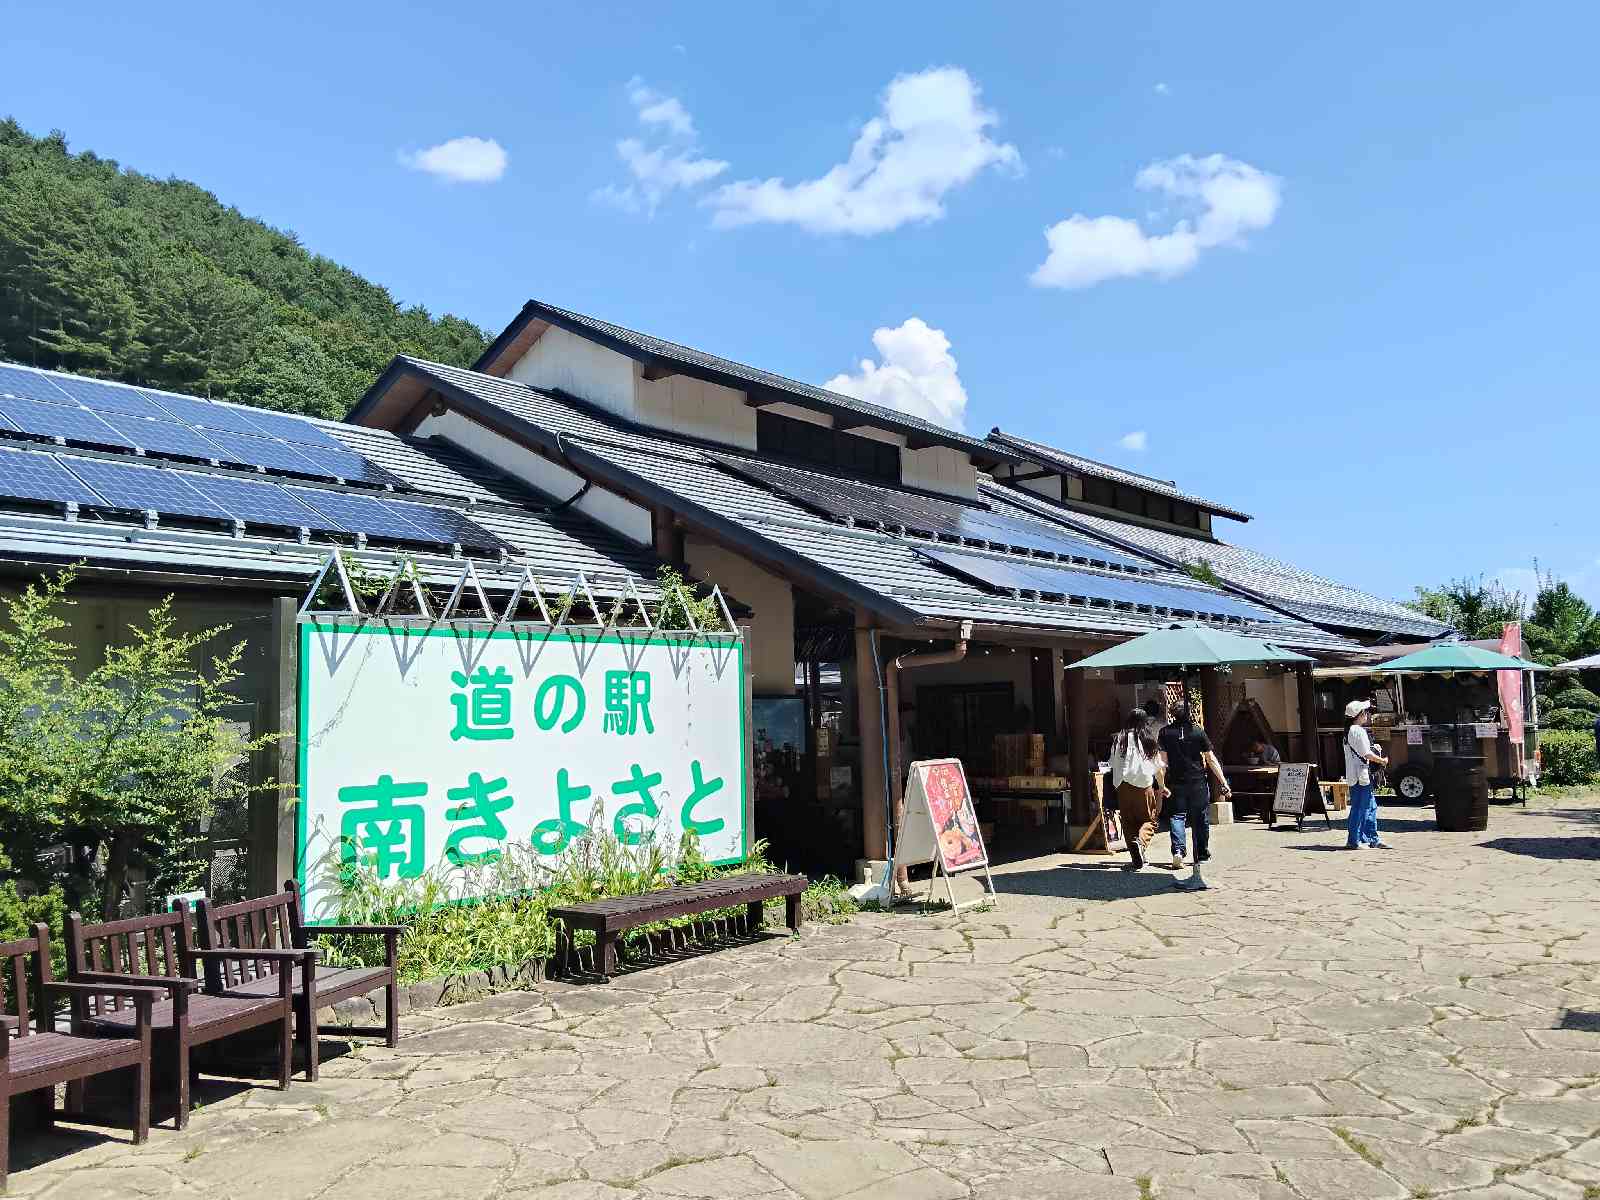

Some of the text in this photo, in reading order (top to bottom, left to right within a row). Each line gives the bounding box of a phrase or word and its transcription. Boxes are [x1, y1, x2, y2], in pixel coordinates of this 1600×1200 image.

[450, 665, 655, 741] 道の駅
[337, 759, 726, 880] 南きよさと
